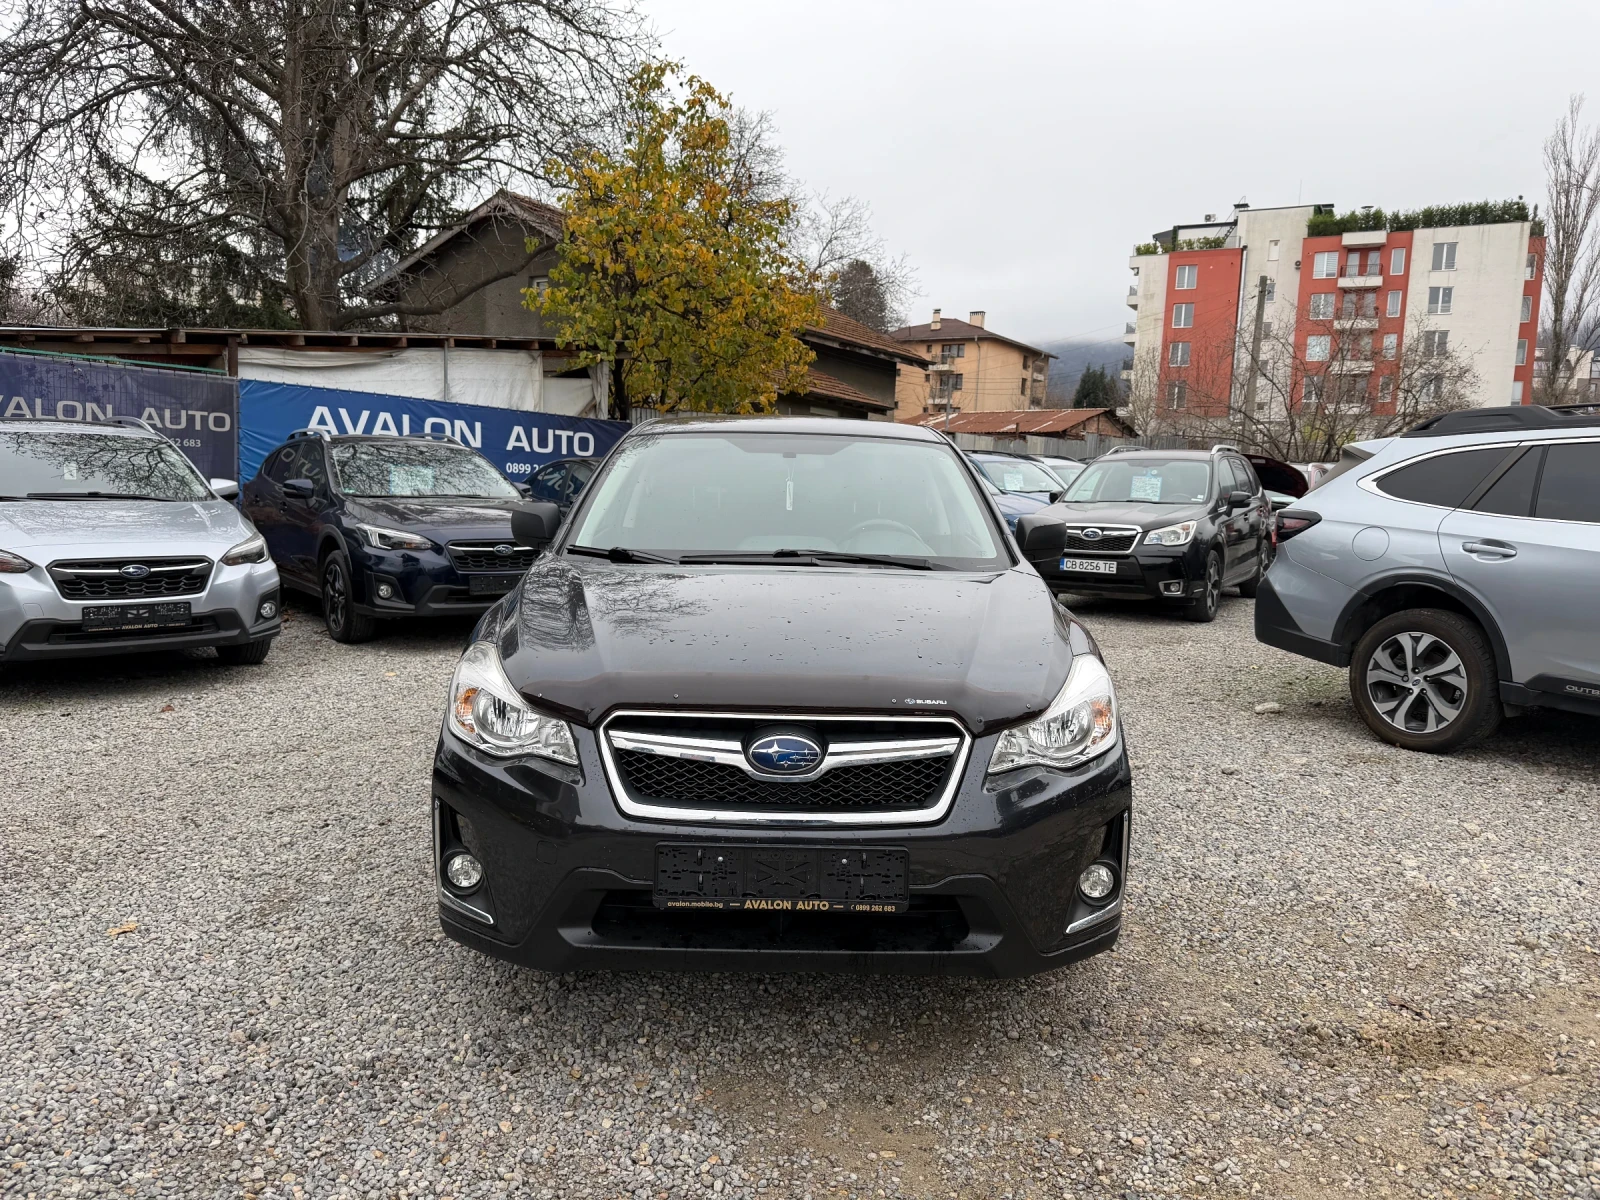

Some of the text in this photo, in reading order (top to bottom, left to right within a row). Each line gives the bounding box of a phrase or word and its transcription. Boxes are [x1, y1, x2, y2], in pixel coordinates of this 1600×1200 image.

[0, 395, 231, 432] ALON AUTO
[307, 405, 595, 457] AVALON AUTO
[183, 438, 201, 447] 683
[506, 462, 531, 474] 0899
[1065, 560, 1115, 573] CB 8256 TE
[667, 900, 724, 909] avalon.mobile.bg
[743, 899, 792, 910] AVALON
[796, 900, 830, 911] AUTO
